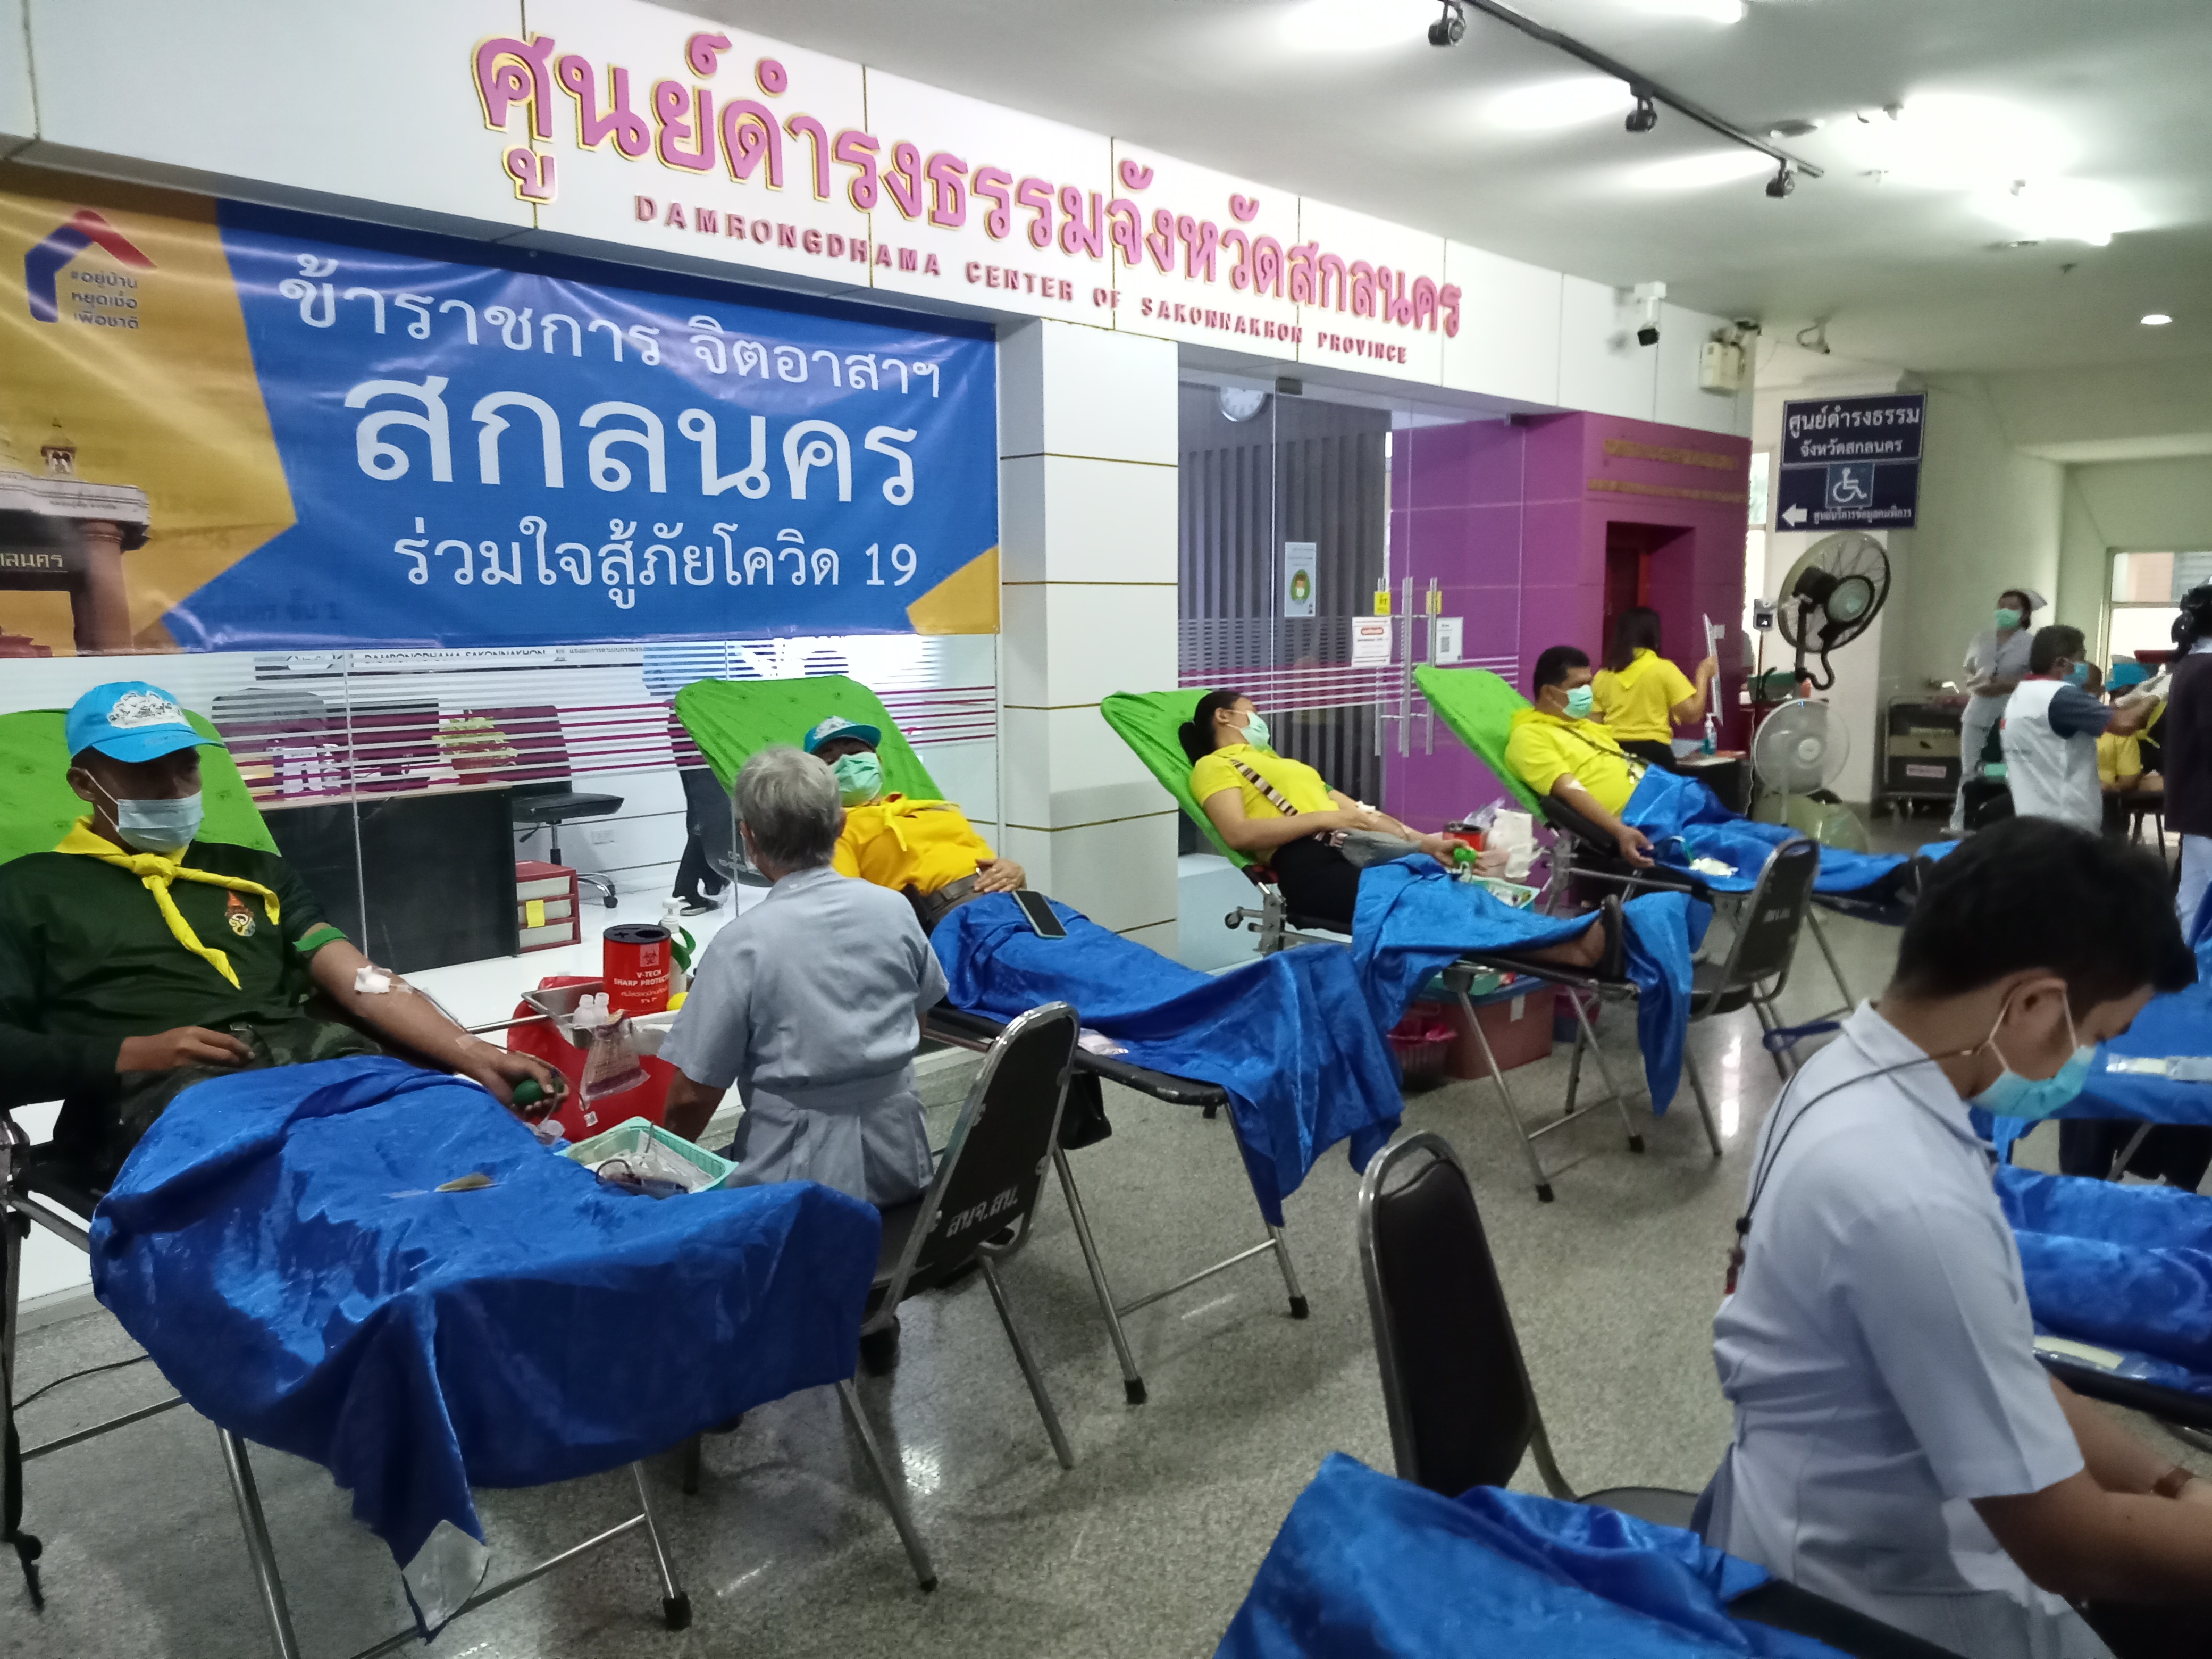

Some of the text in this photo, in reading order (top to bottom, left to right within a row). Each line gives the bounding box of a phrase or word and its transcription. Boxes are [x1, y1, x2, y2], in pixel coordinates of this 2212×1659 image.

[471, 31, 1462, 338] ศูนย์ดำรงธรรมจังหวัดสกลนคร
[278, 253, 940, 398] ข้าราชการ จิตอาสาฯ
[635, 194, 1408, 364] DAMRONGDHAMA CENTER OF SAKONNAKHON PROVINCE
[343, 375, 917, 506] สกลนคร
[1788, 405, 1920, 439] ศูนย์ดำรงธรรม
[394, 515, 840, 609] ร่วมใจสู้ภัยโควิด
[866, 543, 918, 586] 19
[613, 978, 638, 987] SHARP
[636, 969, 662, 978] V-TECH
